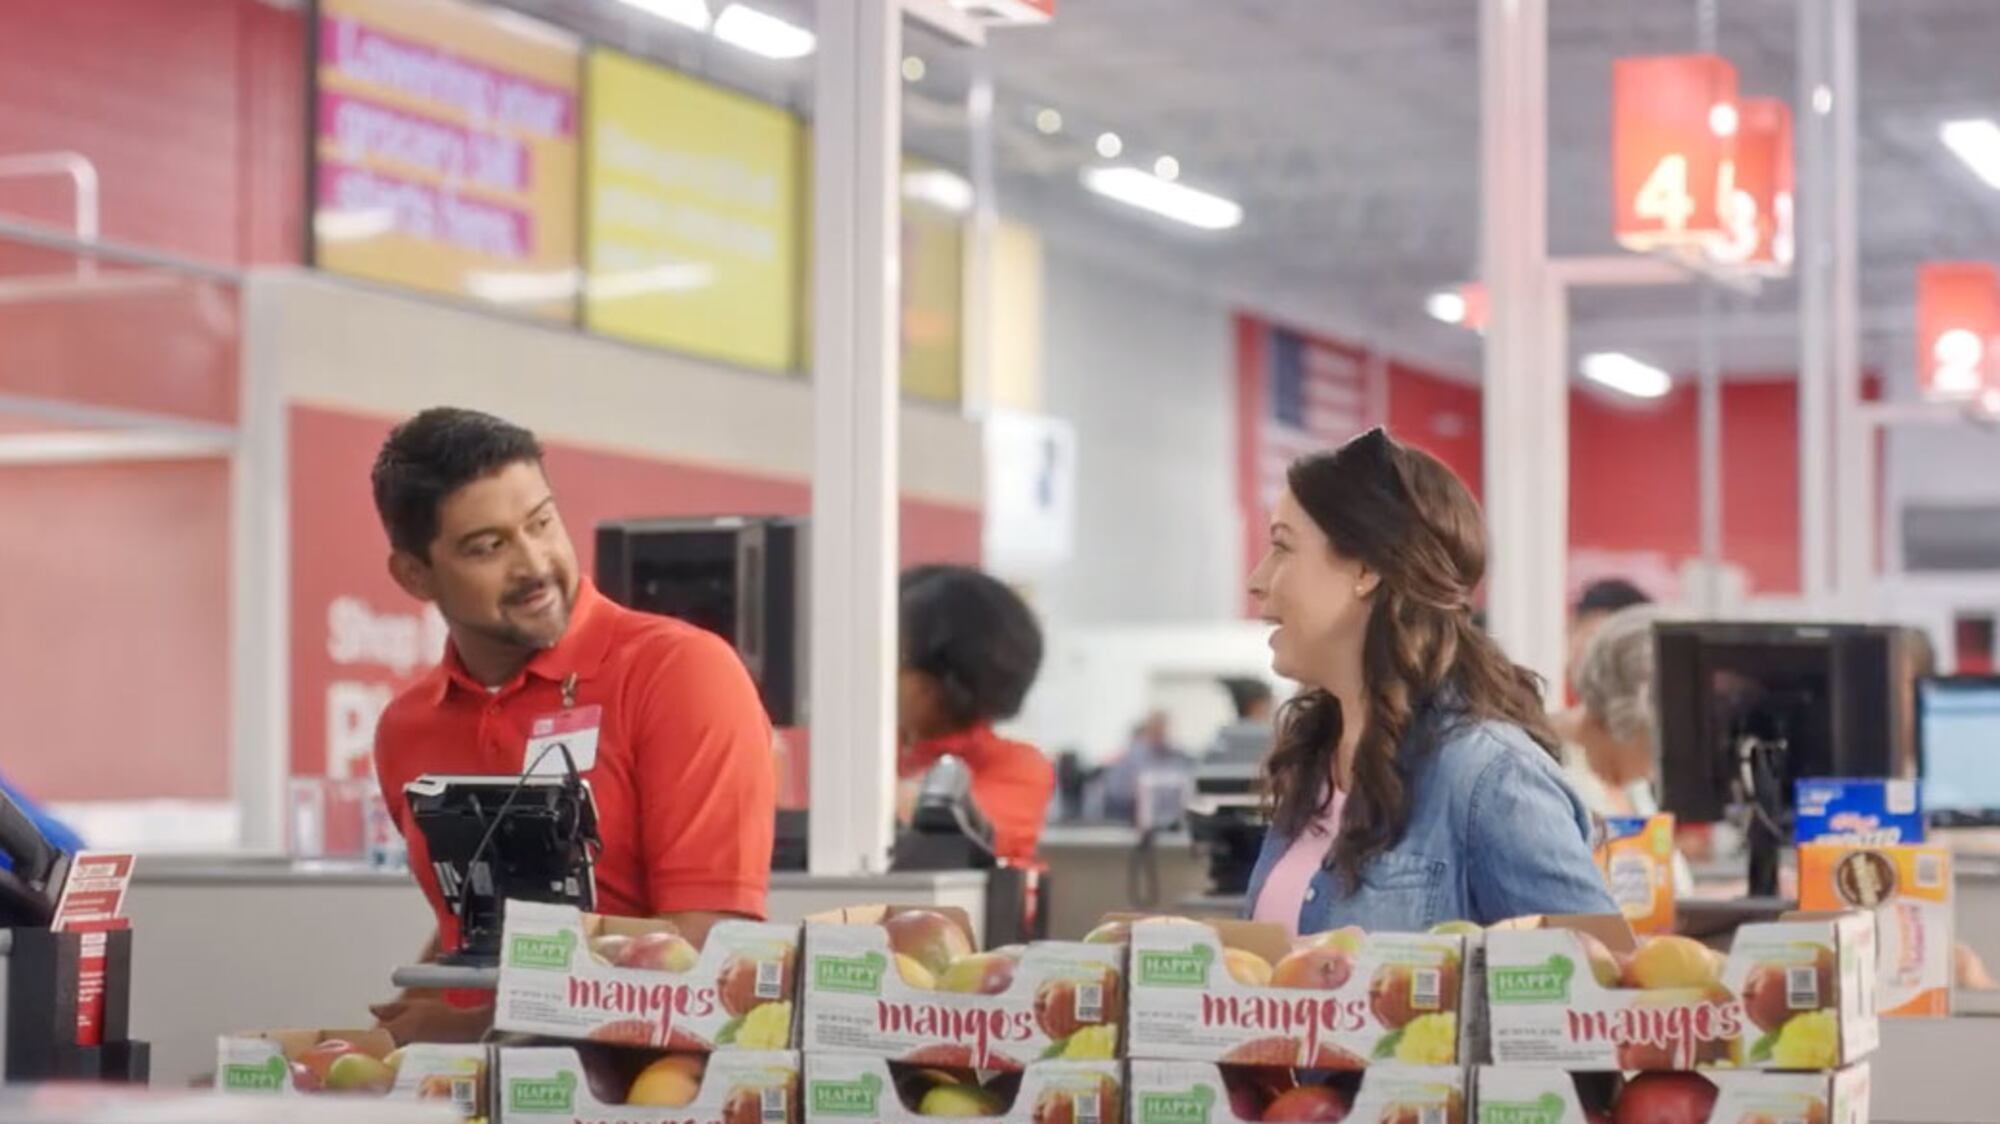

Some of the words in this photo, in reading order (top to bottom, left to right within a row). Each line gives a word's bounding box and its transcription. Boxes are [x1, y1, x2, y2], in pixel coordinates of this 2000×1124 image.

[1633, 153, 1695, 231] 4
[1933, 327, 1982, 392] 2
[516, 938, 568, 957] HAPPY
[820, 962, 877, 982] HAPPY
[1147, 957, 1203, 972] HAPPY
[1500, 973, 1564, 990] HAPPY
[568, 976, 716, 1044] mangos
[875, 1000, 1034, 1068] mangos
[1201, 993, 1368, 1067] mangos
[1565, 1002, 1744, 1069] mangos
[228, 1070, 277, 1088] HAPPY
[516, 1085, 568, 1101] HAPPY
[816, 1086, 873, 1103] HAPPY
[1146, 1099, 1206, 1116] HAPPY
